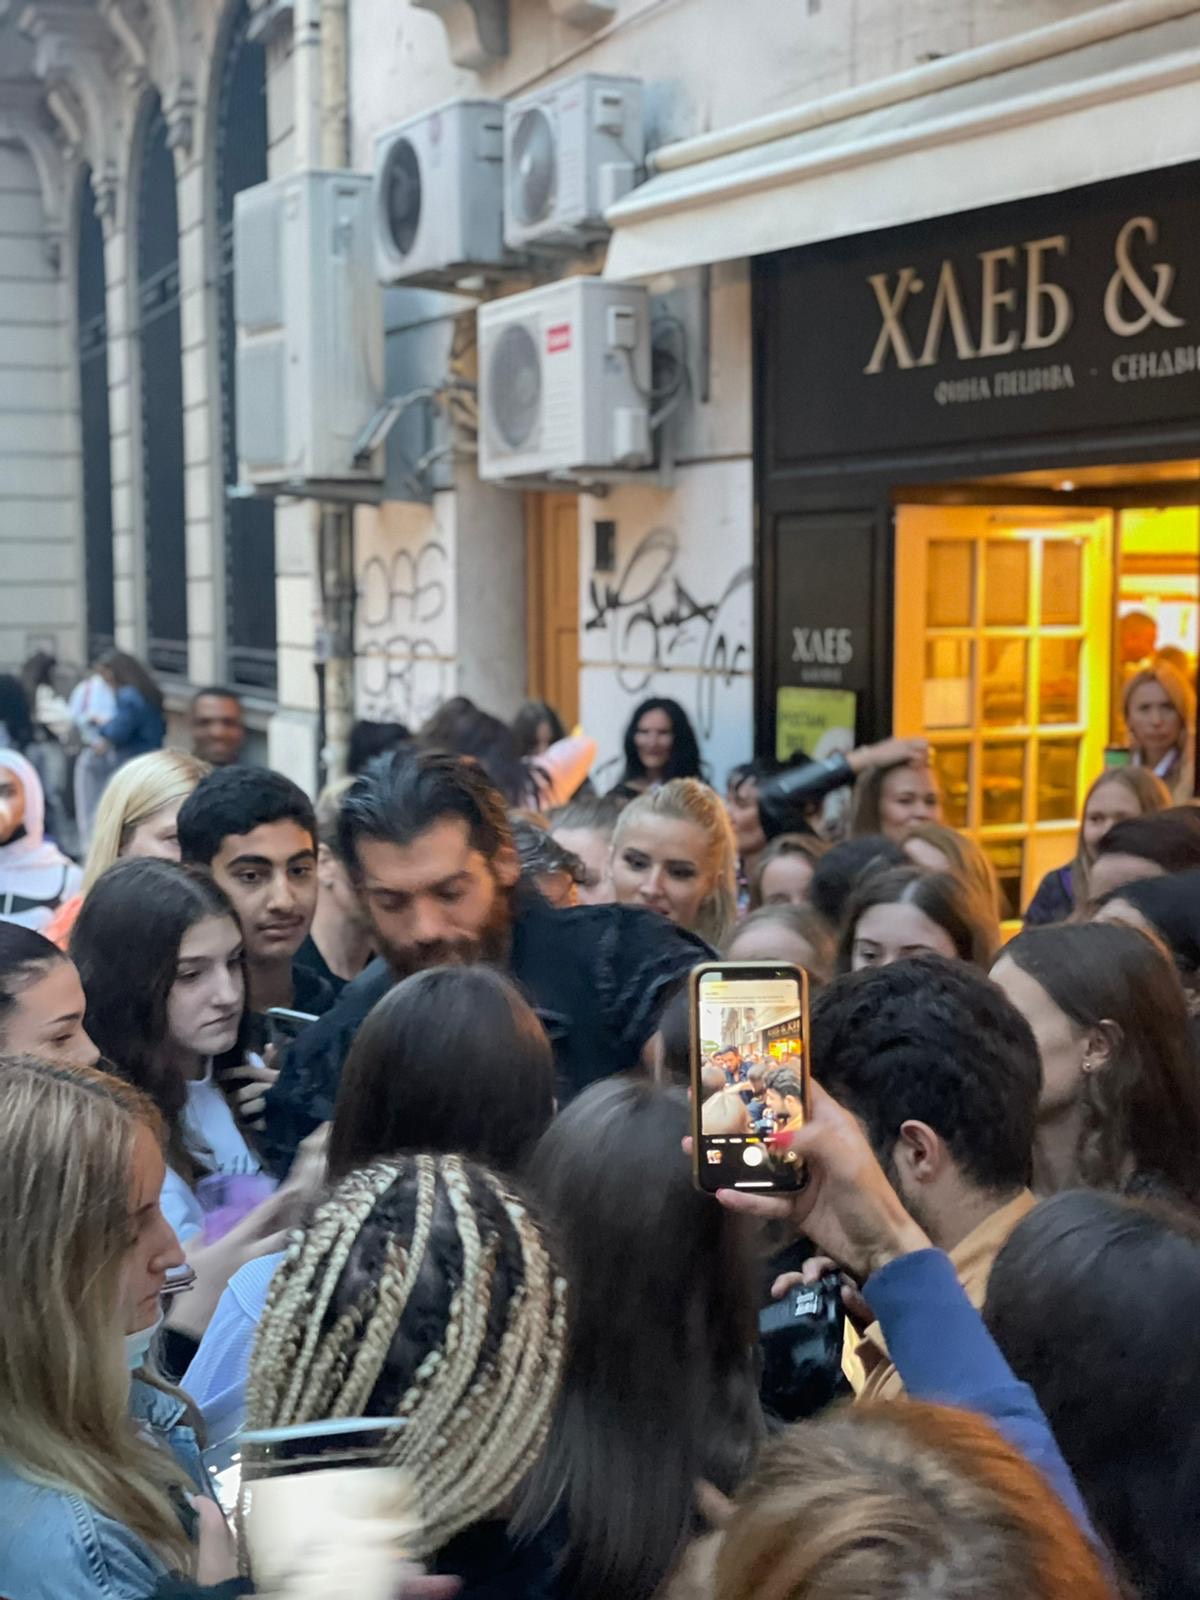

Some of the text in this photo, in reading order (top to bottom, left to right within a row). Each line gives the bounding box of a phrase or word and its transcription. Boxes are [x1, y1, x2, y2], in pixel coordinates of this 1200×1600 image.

[863, 216, 1187, 374] ХЛЕБ &
[792, 627, 853, 664] ХЛЕБ
